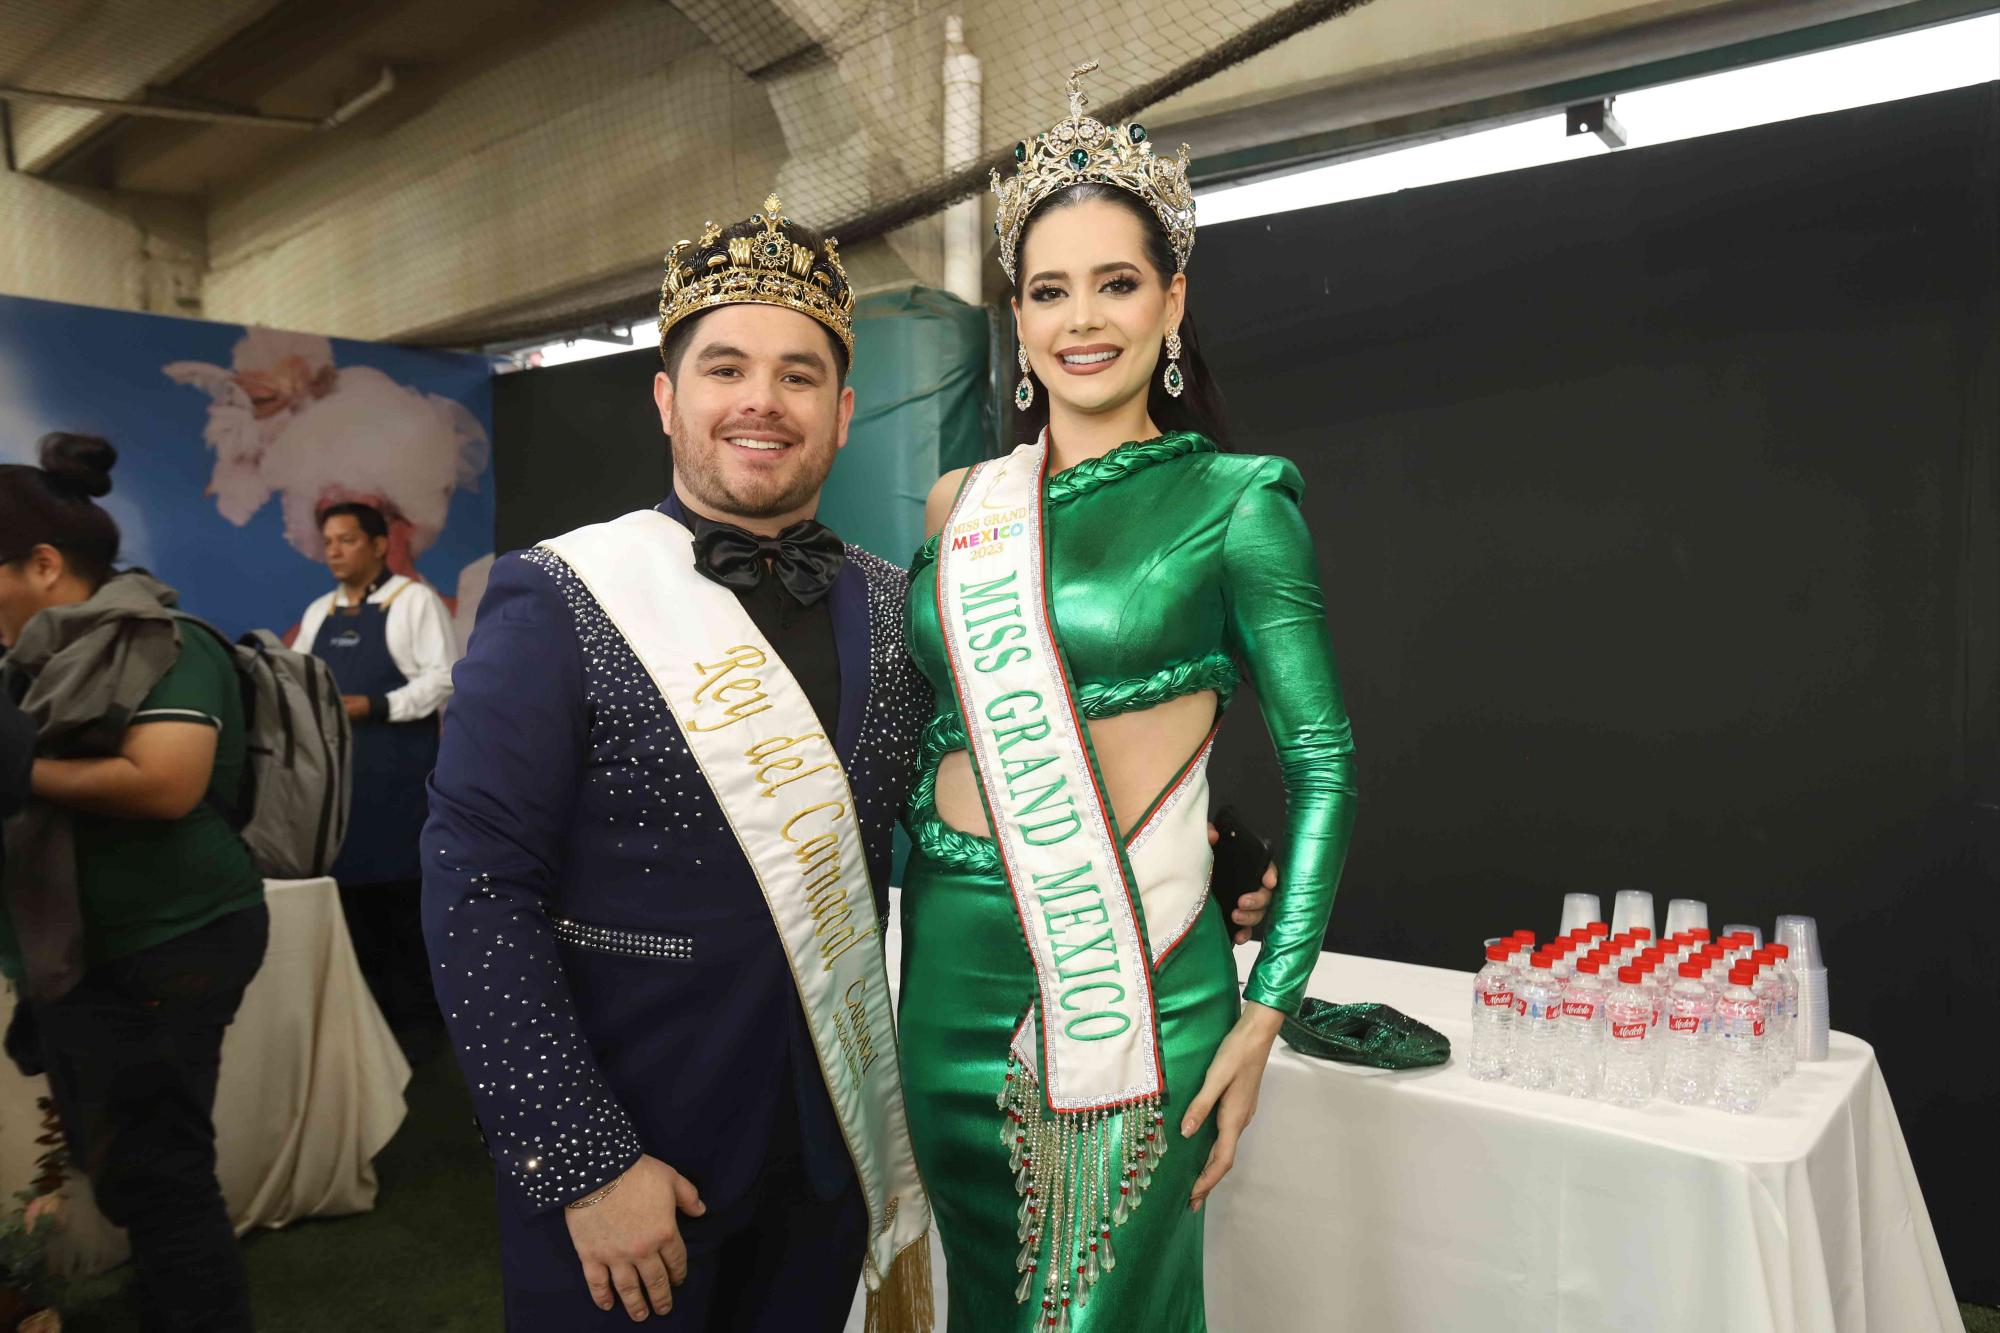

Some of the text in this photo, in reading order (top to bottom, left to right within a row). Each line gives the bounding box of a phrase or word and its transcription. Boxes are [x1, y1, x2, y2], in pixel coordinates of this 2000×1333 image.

[953, 507, 1028, 535] MISS GRAND
[951, 522, 1025, 551] MEXICO
[969, 542, 1005, 561] 2023
[685, 645, 878, 971] Rey del Carnaval
[960, 570, 1131, 1041] MISS GRAND MEXICO
